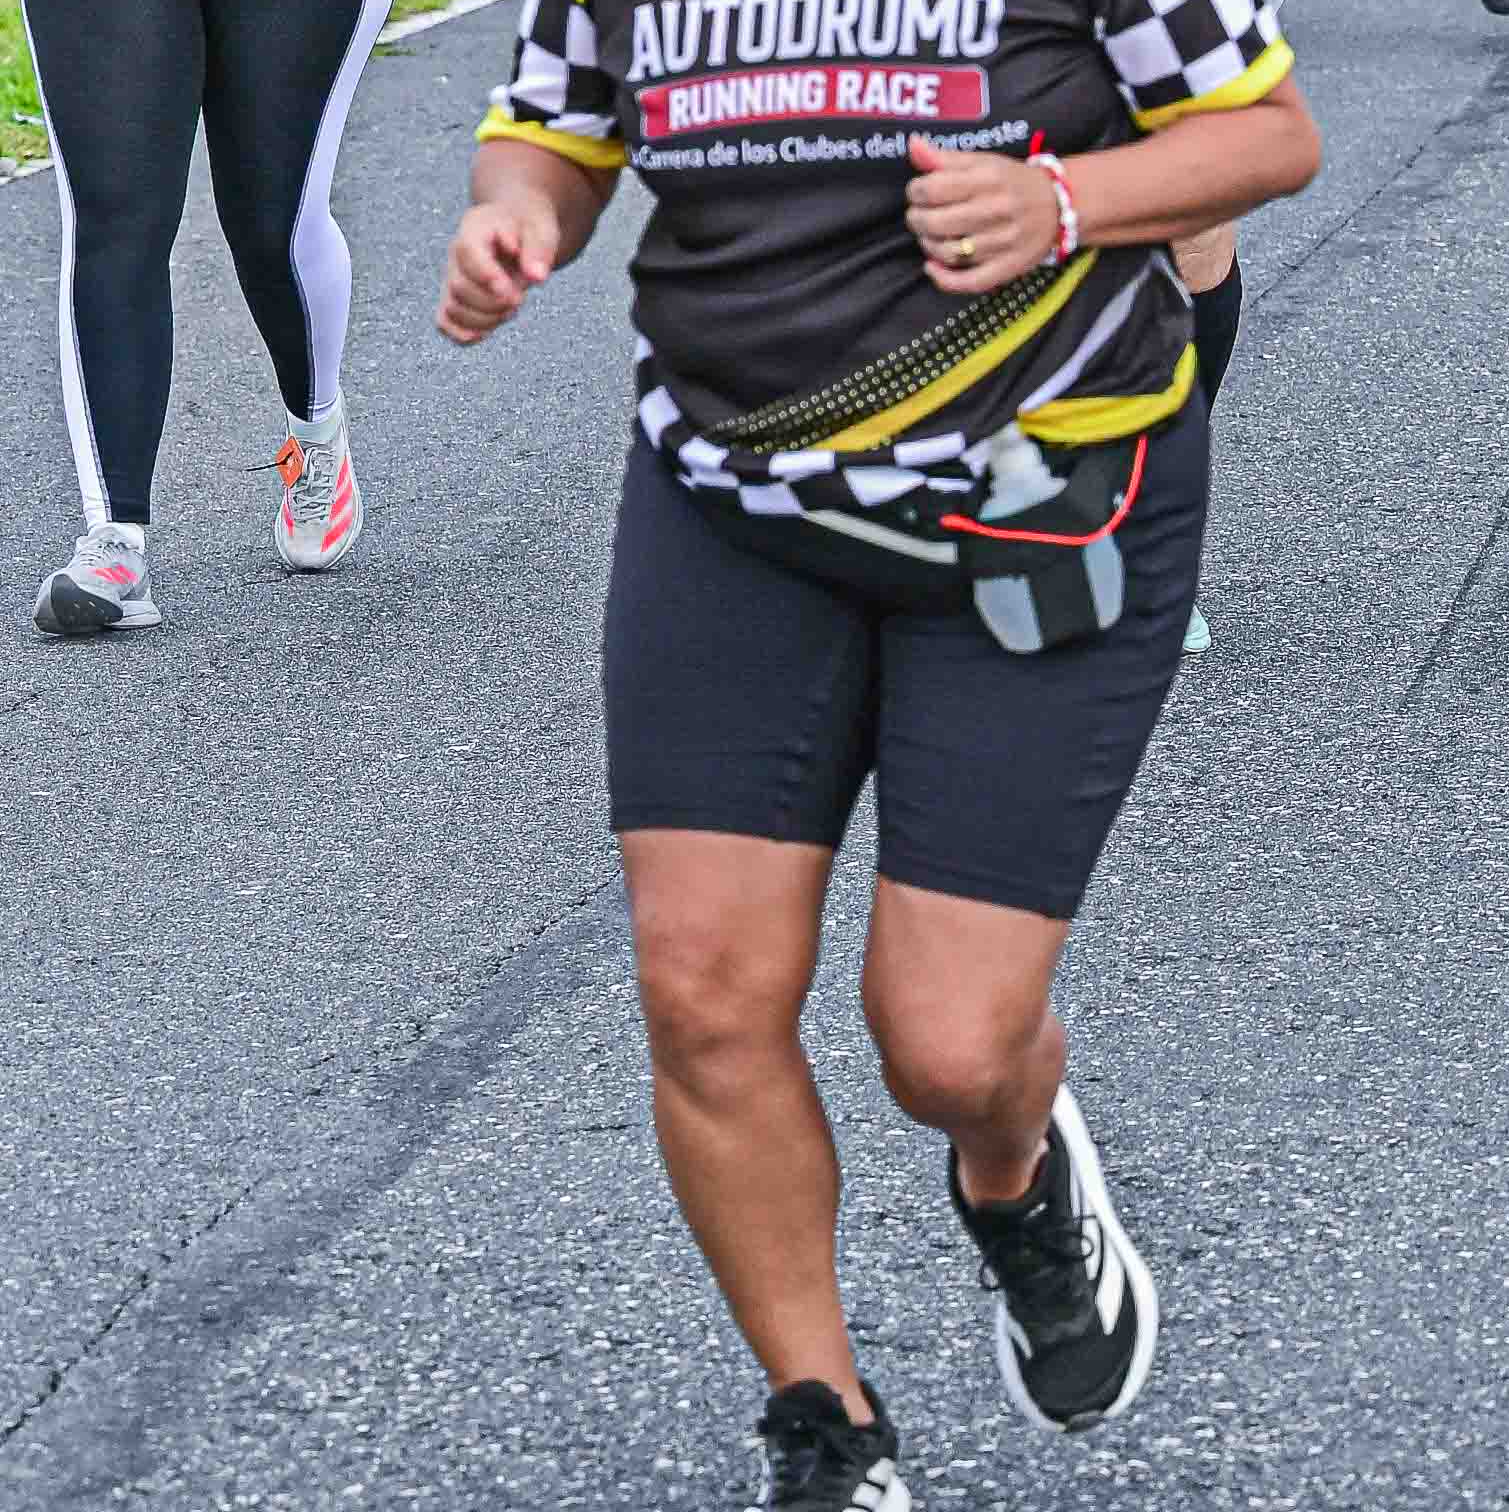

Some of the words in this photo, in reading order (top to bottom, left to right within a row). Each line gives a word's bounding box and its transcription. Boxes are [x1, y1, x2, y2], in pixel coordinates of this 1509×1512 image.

[668, 72, 827, 131] RUNNING
[835, 70, 941, 118] RACE
[707, 141, 739, 167] de
[742, 138, 778, 165] los
[780, 136, 860, 162] Clubes
[866, 131, 905, 158] del
